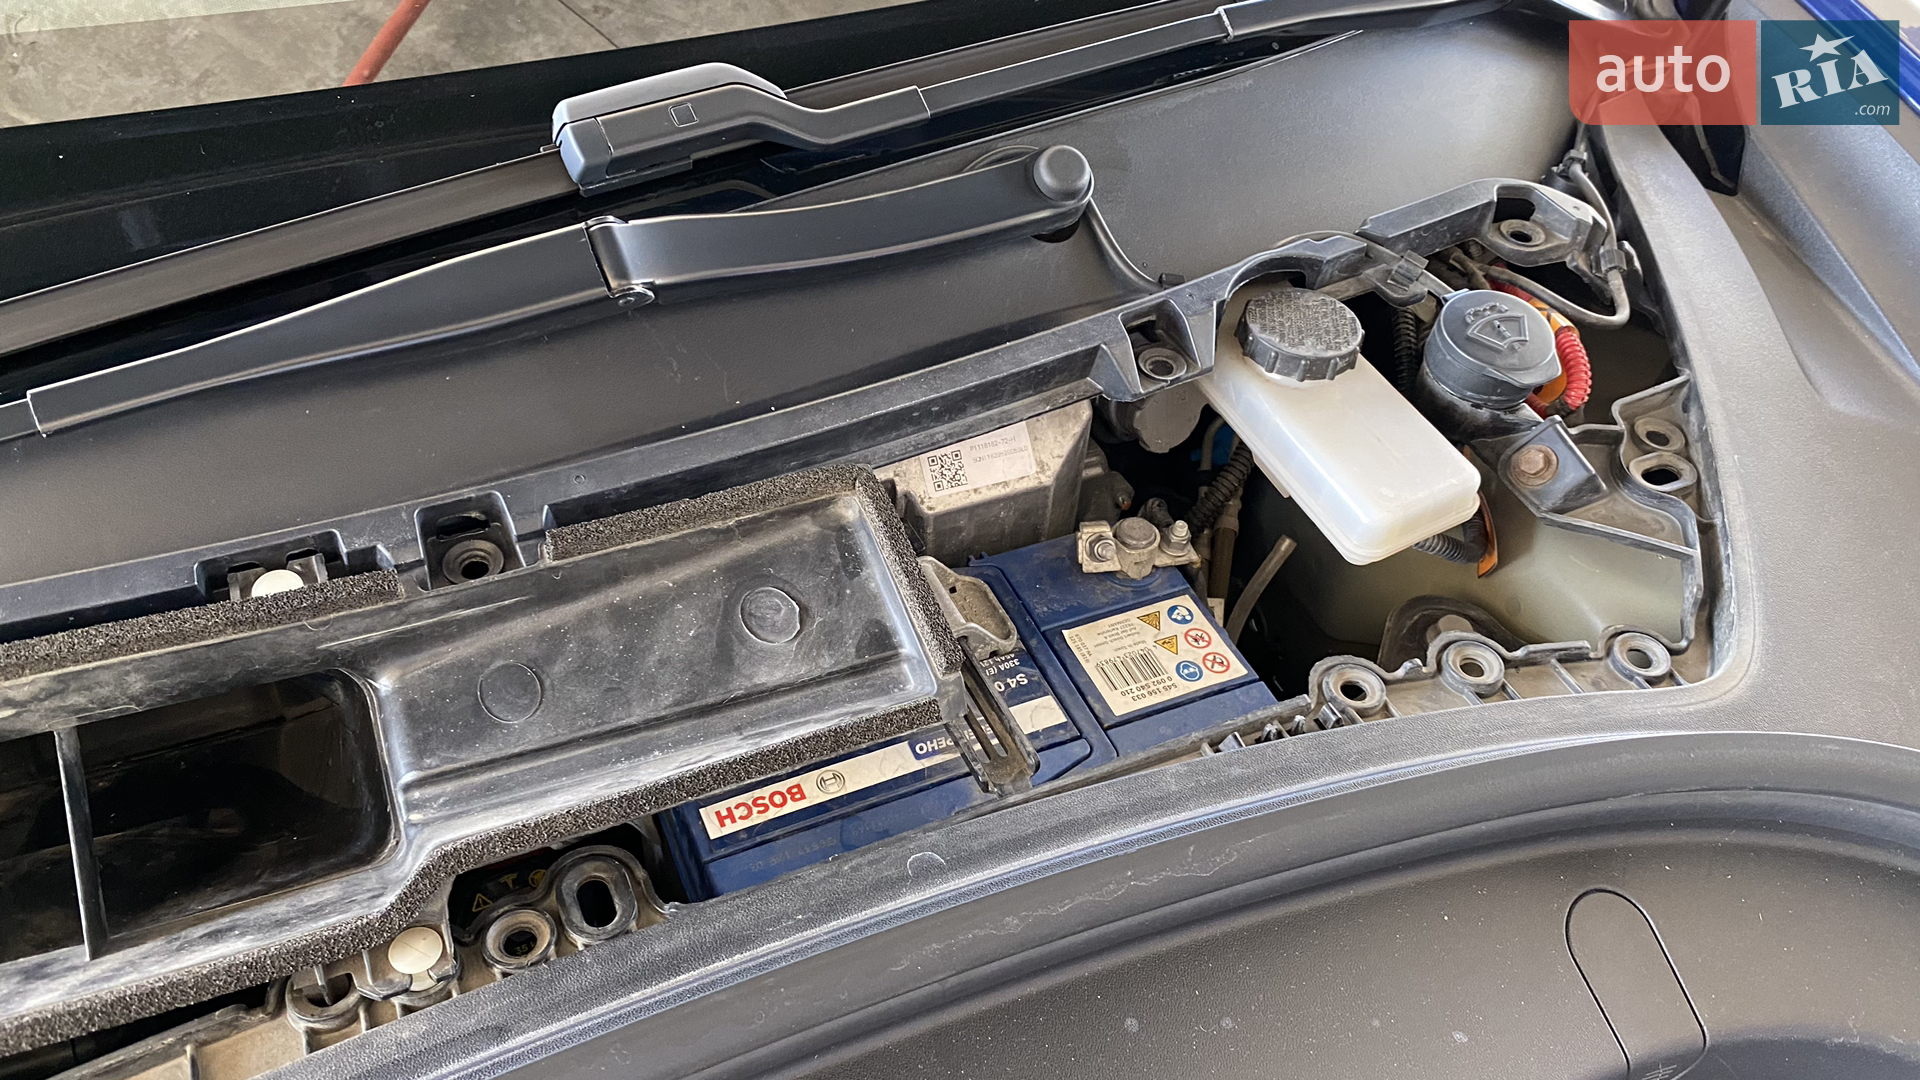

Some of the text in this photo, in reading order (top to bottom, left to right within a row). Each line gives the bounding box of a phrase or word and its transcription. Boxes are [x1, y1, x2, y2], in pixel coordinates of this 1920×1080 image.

[997, 657, 1021, 671] 330A
[1005, 672, 1029, 689] S4
[1135, 682, 1151, 692] 540
[1151, 678, 1166, 687] 092
[1120, 688, 1135, 697] 210
[1131, 682, 1178, 702] 545 156 033
[714, 783, 807, 828] BOSCH
